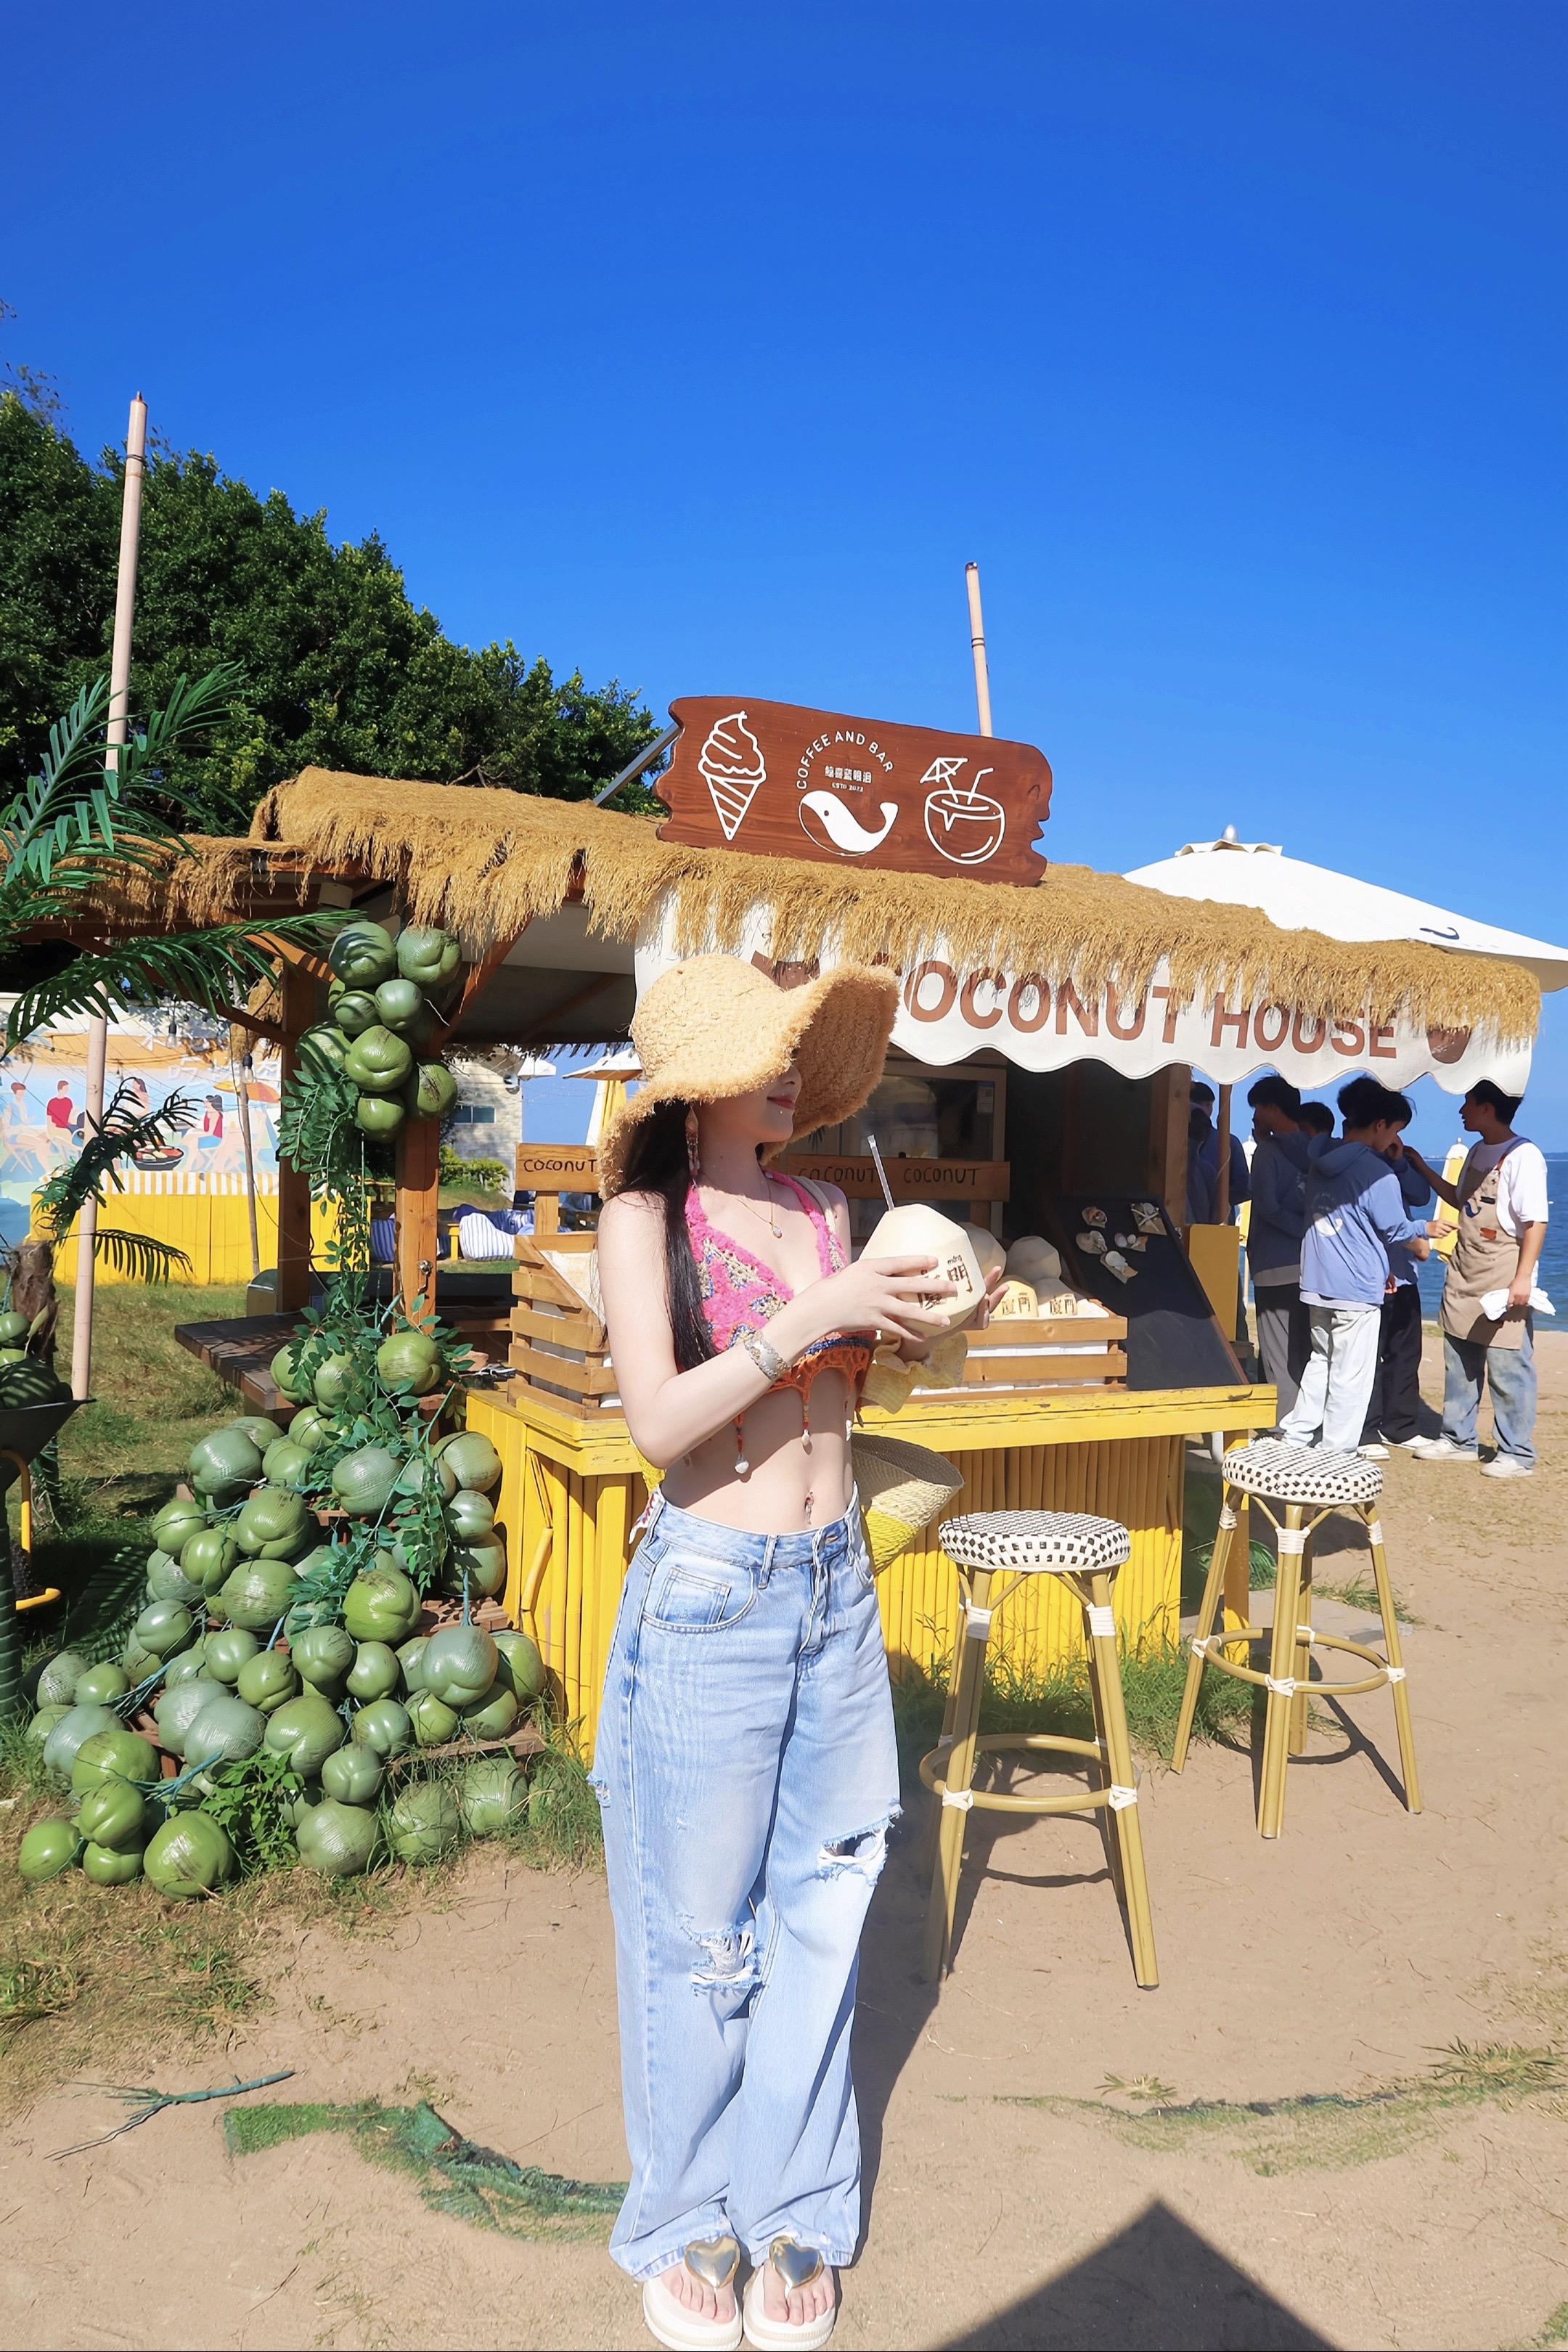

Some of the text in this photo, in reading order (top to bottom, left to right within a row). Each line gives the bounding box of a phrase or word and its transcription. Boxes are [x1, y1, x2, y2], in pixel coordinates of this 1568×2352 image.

[796, 730, 894, 790] COFFEE AND BAR
[849, 784, 864, 793] 2022
[871, 952, 1397, 1059] OCONUT HOUSE
